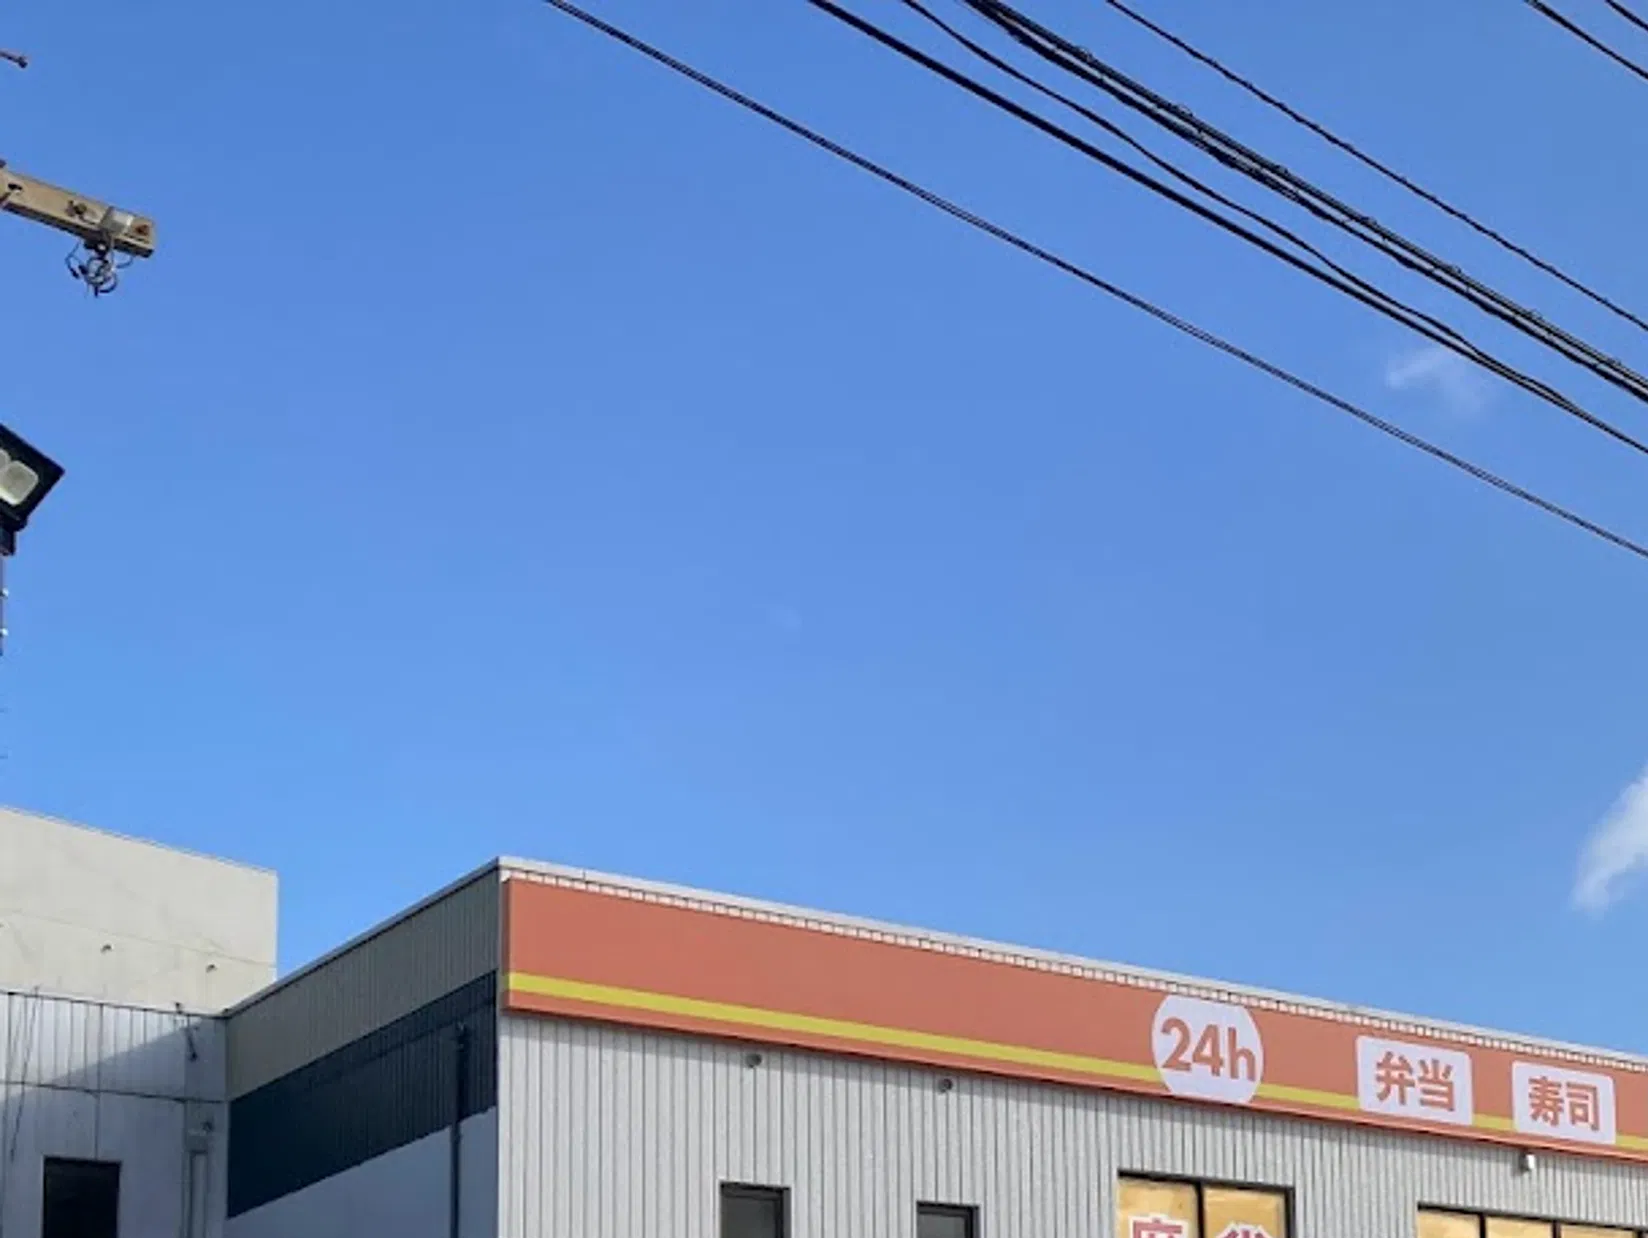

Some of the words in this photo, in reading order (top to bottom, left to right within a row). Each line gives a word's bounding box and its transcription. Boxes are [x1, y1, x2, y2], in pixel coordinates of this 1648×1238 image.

[1160, 1017, 1257, 1082] 24h
[1374, 1050, 1455, 1112] 弁当
[1527, 1076, 1600, 1132] 寿司
